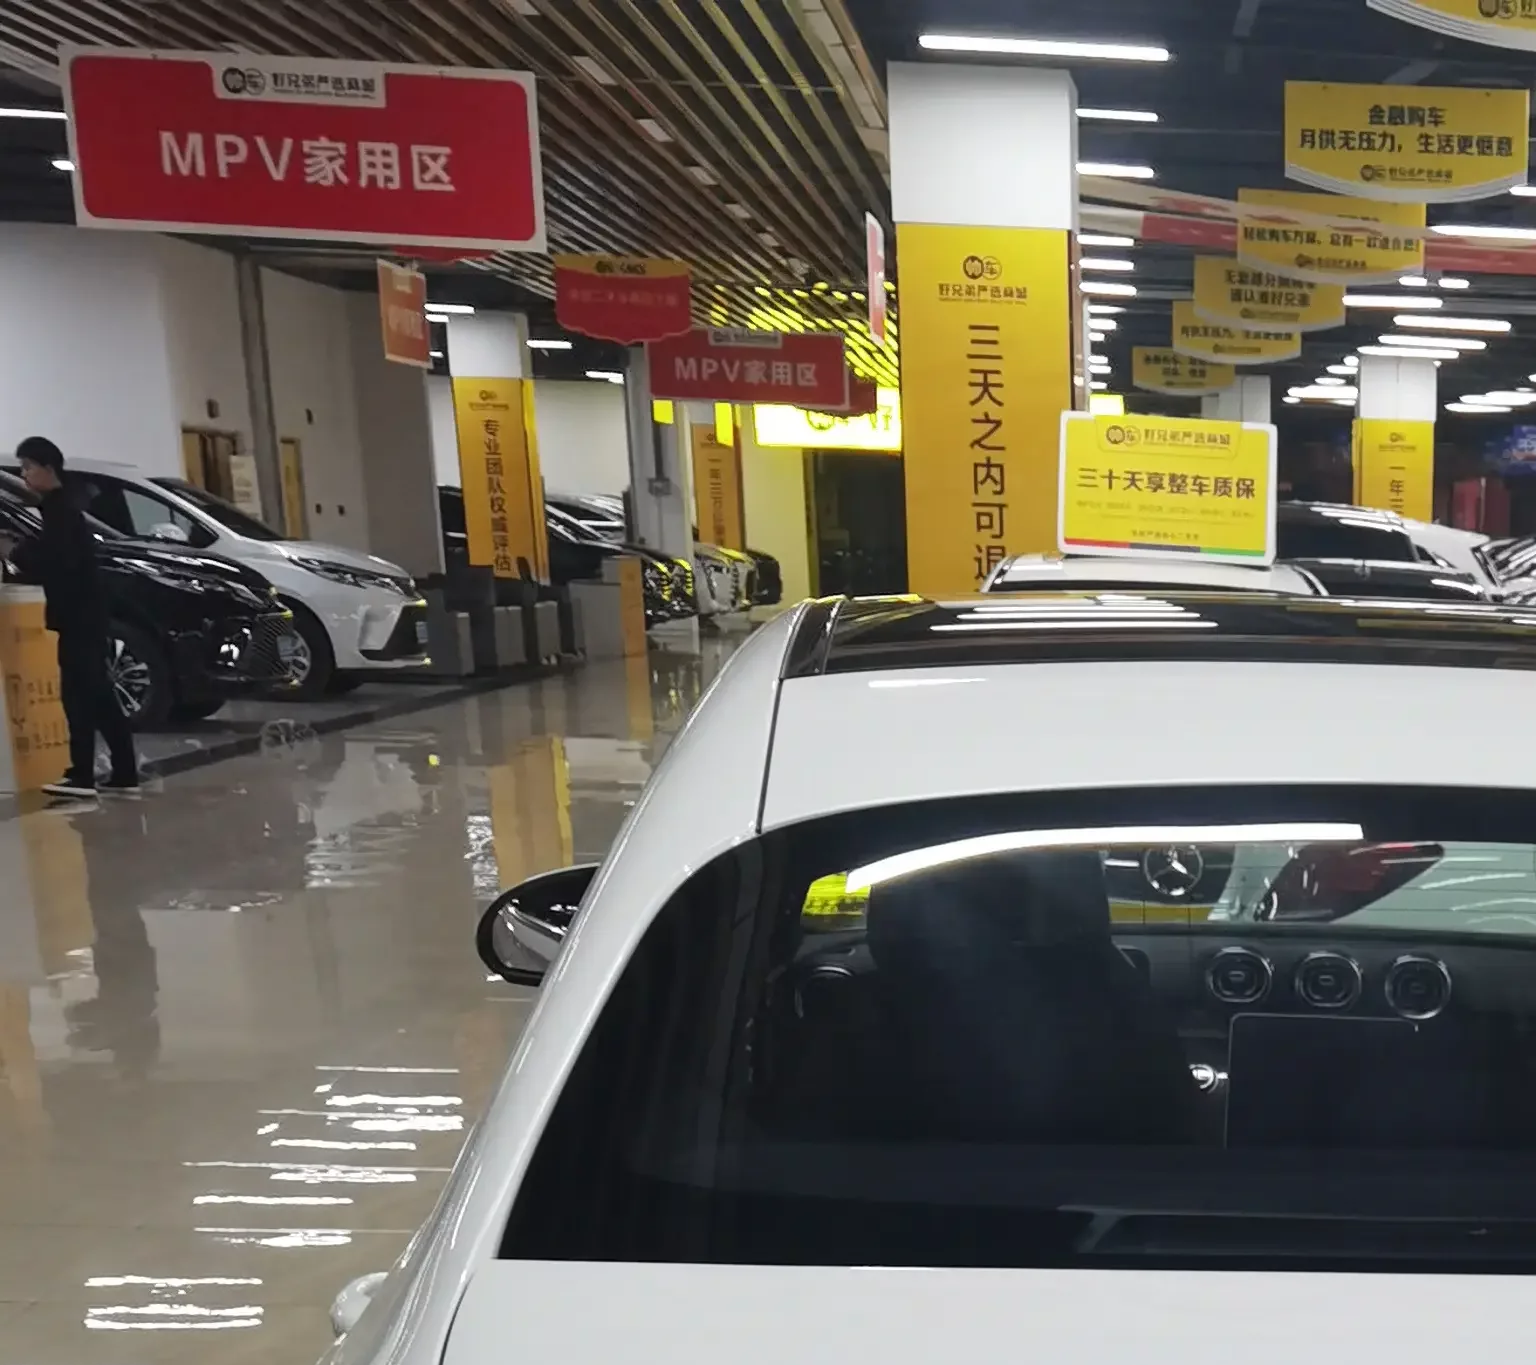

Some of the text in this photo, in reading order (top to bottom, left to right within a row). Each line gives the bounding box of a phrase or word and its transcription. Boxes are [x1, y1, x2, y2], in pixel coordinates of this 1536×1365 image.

[158, 130, 456, 192] MPV家用区
[674, 355, 819, 387] MPV家用区
[966, 324, 1010, 591] 三天之内可退
[1076, 467, 1257, 499] 三十天享整车质保
